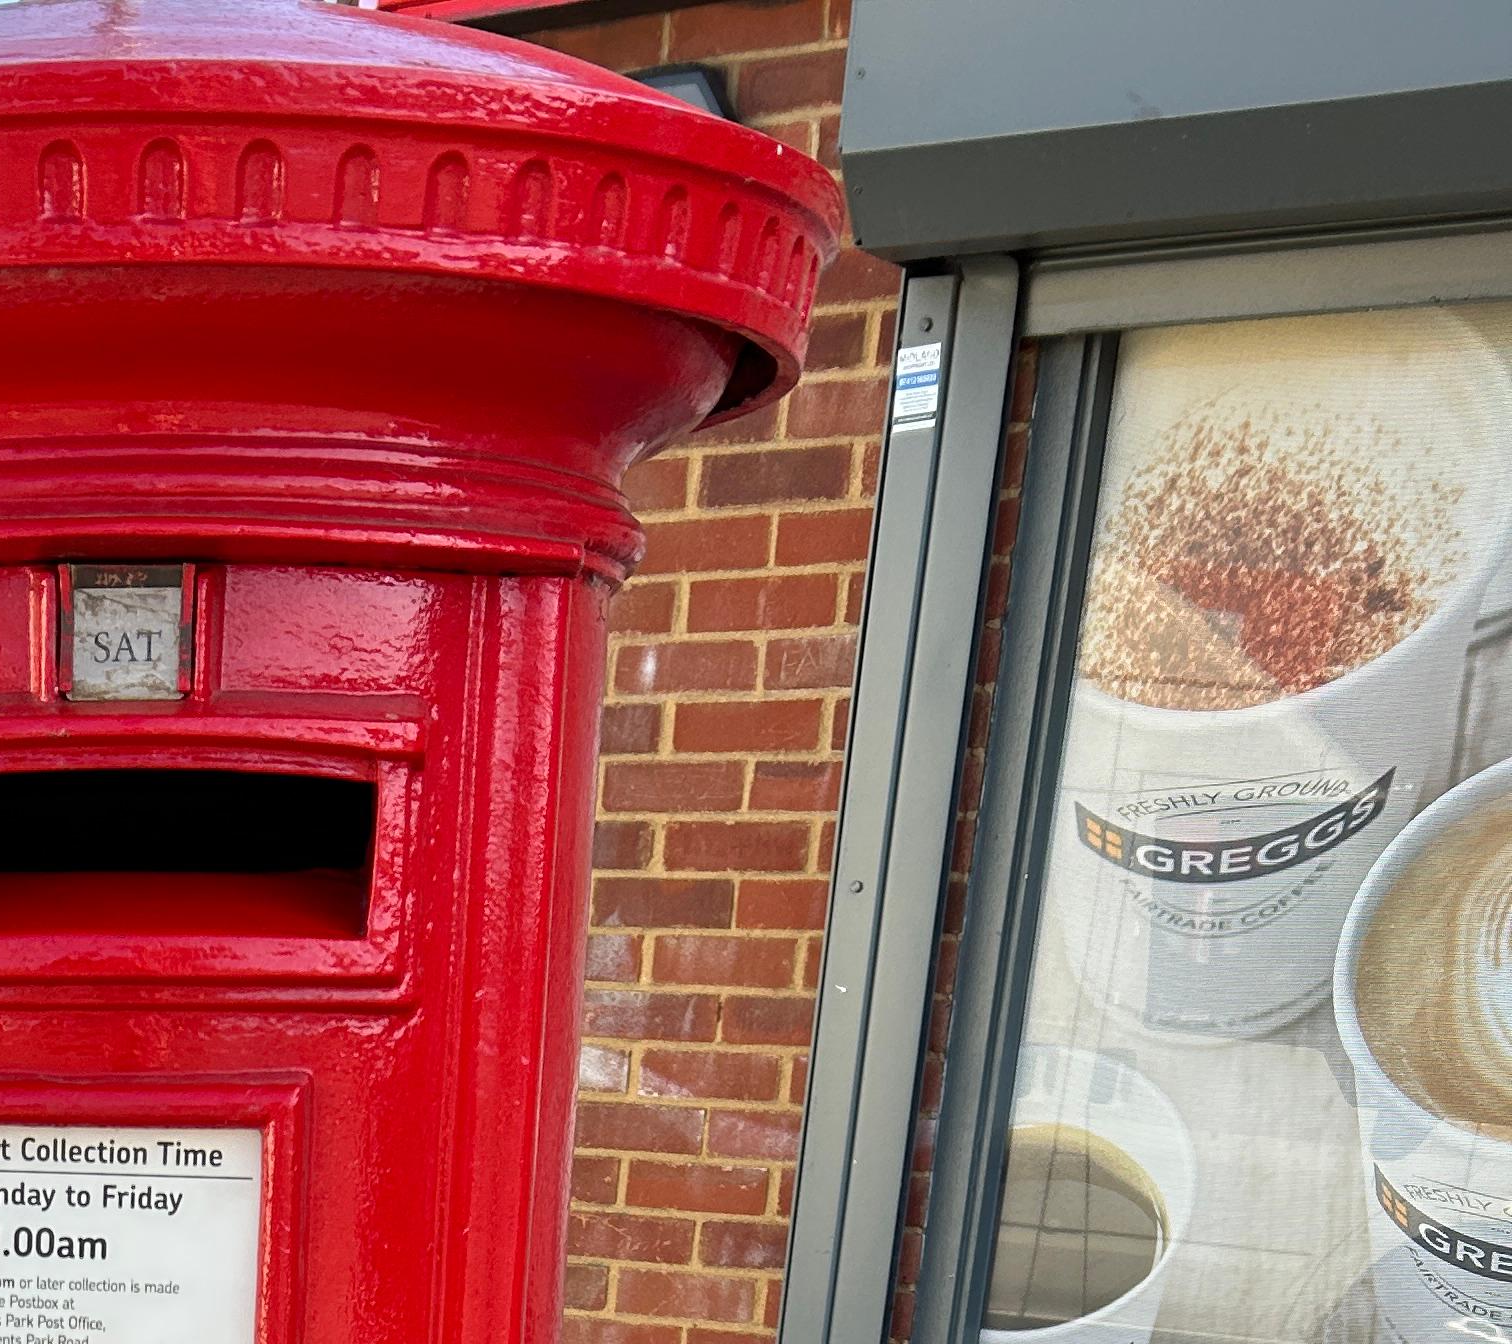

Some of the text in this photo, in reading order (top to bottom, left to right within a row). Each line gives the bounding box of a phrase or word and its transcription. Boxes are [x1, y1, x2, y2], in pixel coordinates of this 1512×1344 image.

[94, 629, 162, 663] SAT
[1118, 776, 1350, 821] FRESHLY GROUND
[1136, 787, 1378, 876] GREGGS
[21, 1137, 148, 1165] Collection
[157, 1141, 224, 1167] Time
[66, 1185, 90, 1208] to
[102, 1184, 184, 1216] Friday
[1404, 1184, 1492, 1211] FRESHLY
[19, 1278, 33, 1290] or
[36, 1276, 65, 1291] later
[68, 1278, 126, 1293] collection
[130, 1279, 141, 1293] is
[144, 1281, 180, 1295] made
[9, 1294, 58, 1310] Postbox
[62, 1298, 75, 1311] at
[6, 1313, 34, 1329] Park
[37, 1315, 64, 1330] Post
[68, 1316, 107, 1333] Office,
